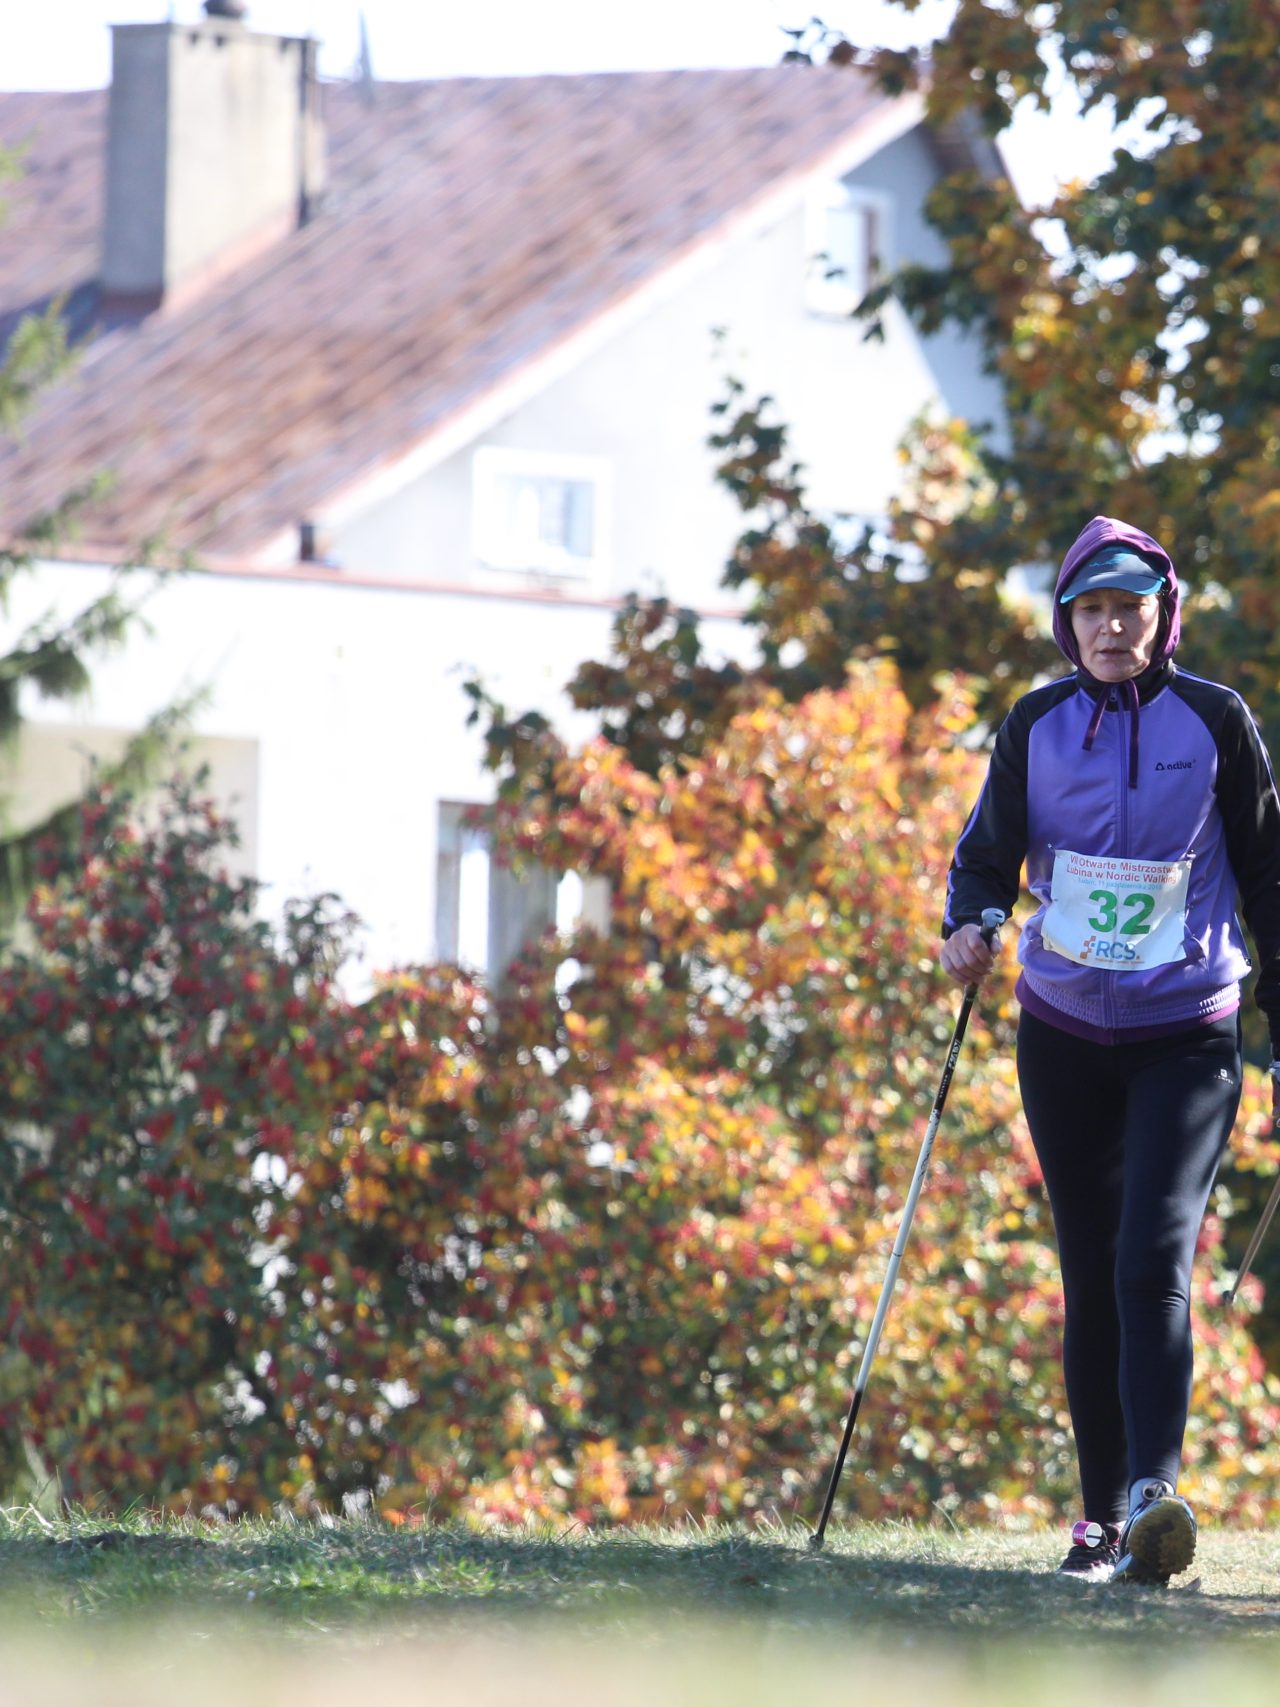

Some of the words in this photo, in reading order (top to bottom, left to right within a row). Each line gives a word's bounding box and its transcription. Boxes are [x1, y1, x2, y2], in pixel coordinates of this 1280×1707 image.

[1066, 863, 1093, 877] Lubina
[1106, 871, 1140, 881] Nordic
[1079, 858, 1117, 869] Otwarte
[1088, 889, 1155, 935] 32
